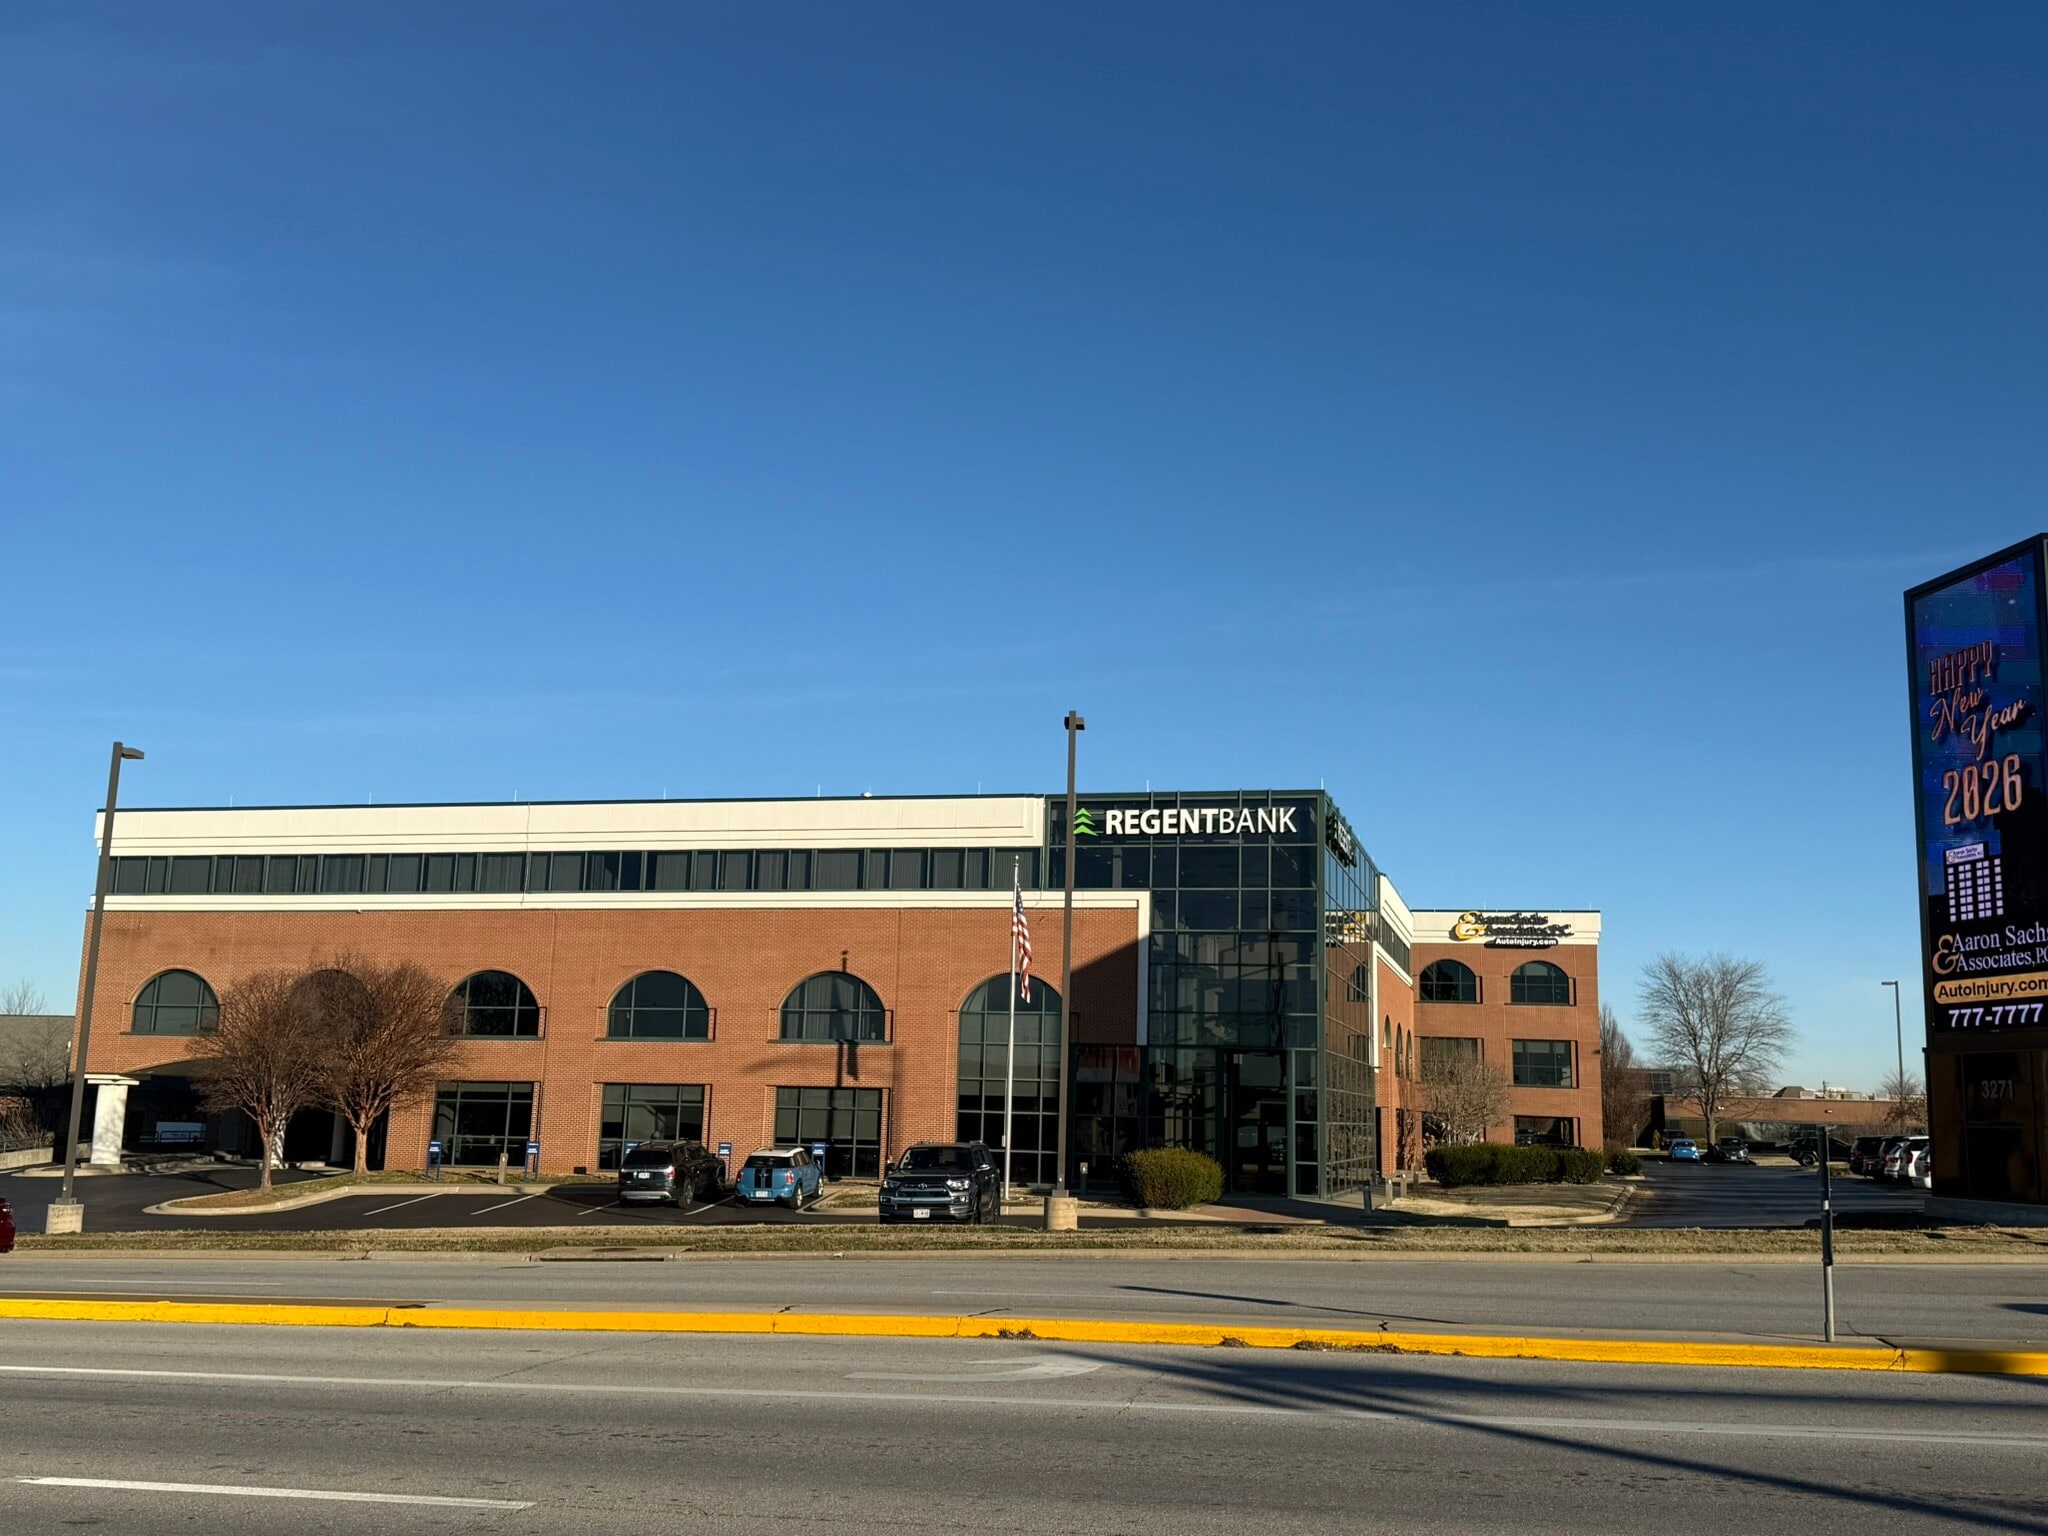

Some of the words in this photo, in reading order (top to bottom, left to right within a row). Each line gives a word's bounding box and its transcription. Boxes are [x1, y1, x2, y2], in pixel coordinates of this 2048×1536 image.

[1928, 639, 1993, 696] HAPPY
[1930, 686, 1984, 741] New
[1961, 698, 2027, 762] Year
[1943, 753, 2023, 825] 2026
[1105, 807, 1298, 836] REGENTBANK
[1932, 934, 1960, 975] &
[1952, 933, 2001, 953] Aaron
[1938, 978, 2048, 999] AutoInjury.com
[1948, 1003, 2044, 1028] 777-7777
[1981, 1079, 2014, 1100] 3271
